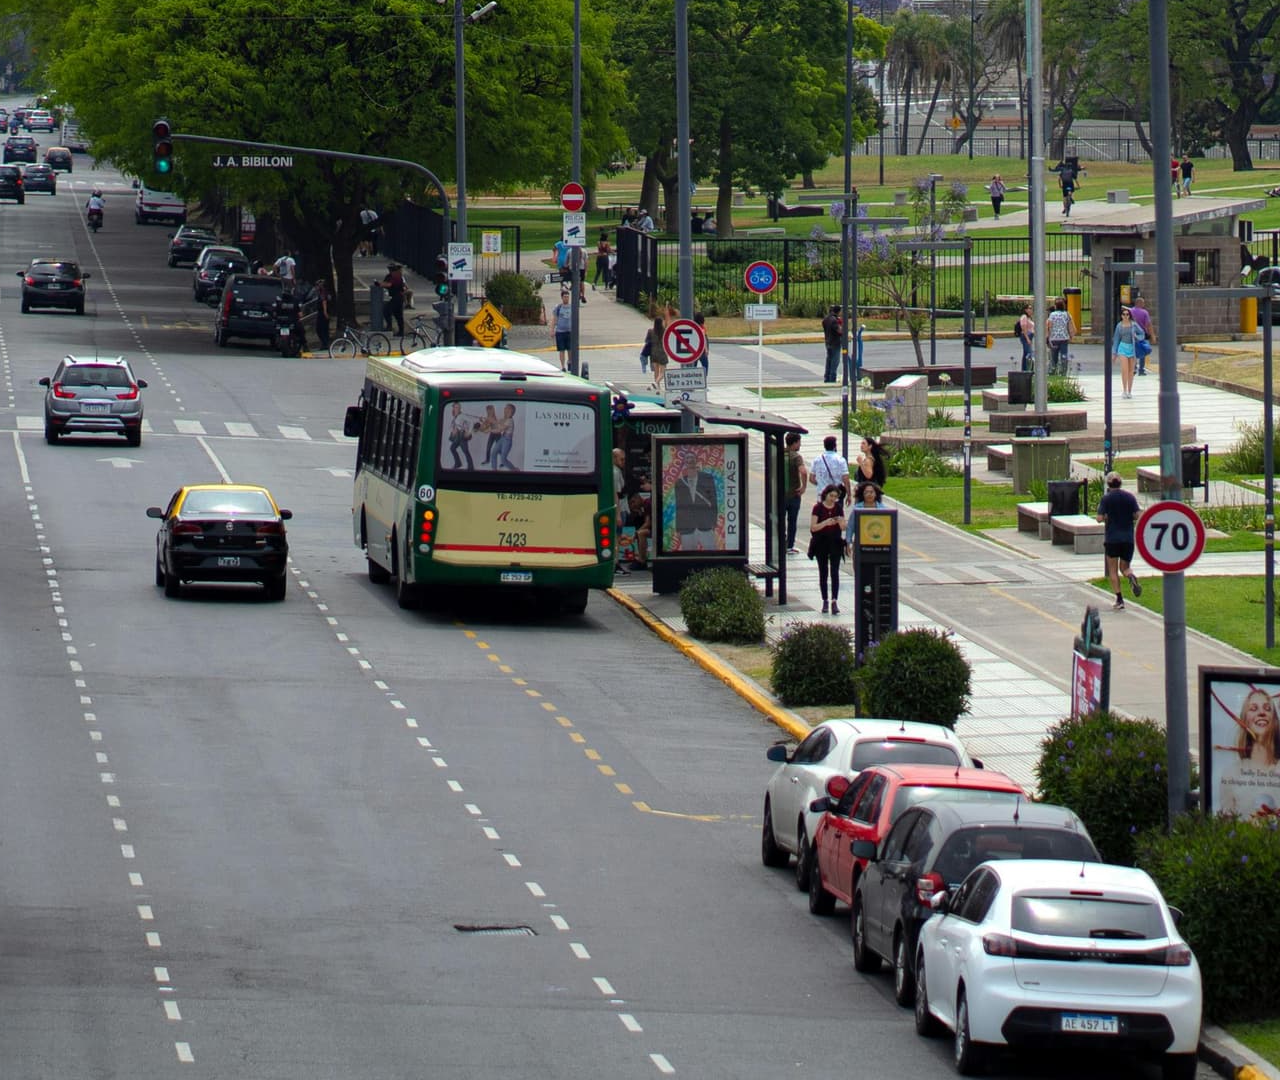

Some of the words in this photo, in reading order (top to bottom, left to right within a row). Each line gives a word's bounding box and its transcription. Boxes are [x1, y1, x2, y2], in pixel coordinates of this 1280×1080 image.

[213, 156, 223, 167] J.
[226, 156, 239, 167] A.
[242, 156, 293, 167] BIBILONI
[419, 487, 432, 499] 60
[726, 460, 737, 535] ROCHAS
[498, 532, 527, 547] 7423
[1150, 522, 1190, 551] 70
[1065, 1019, 1077, 1029] AE
[1080, 1020, 1099, 1030] 457
[1102, 1021, 1115, 1032] LT
